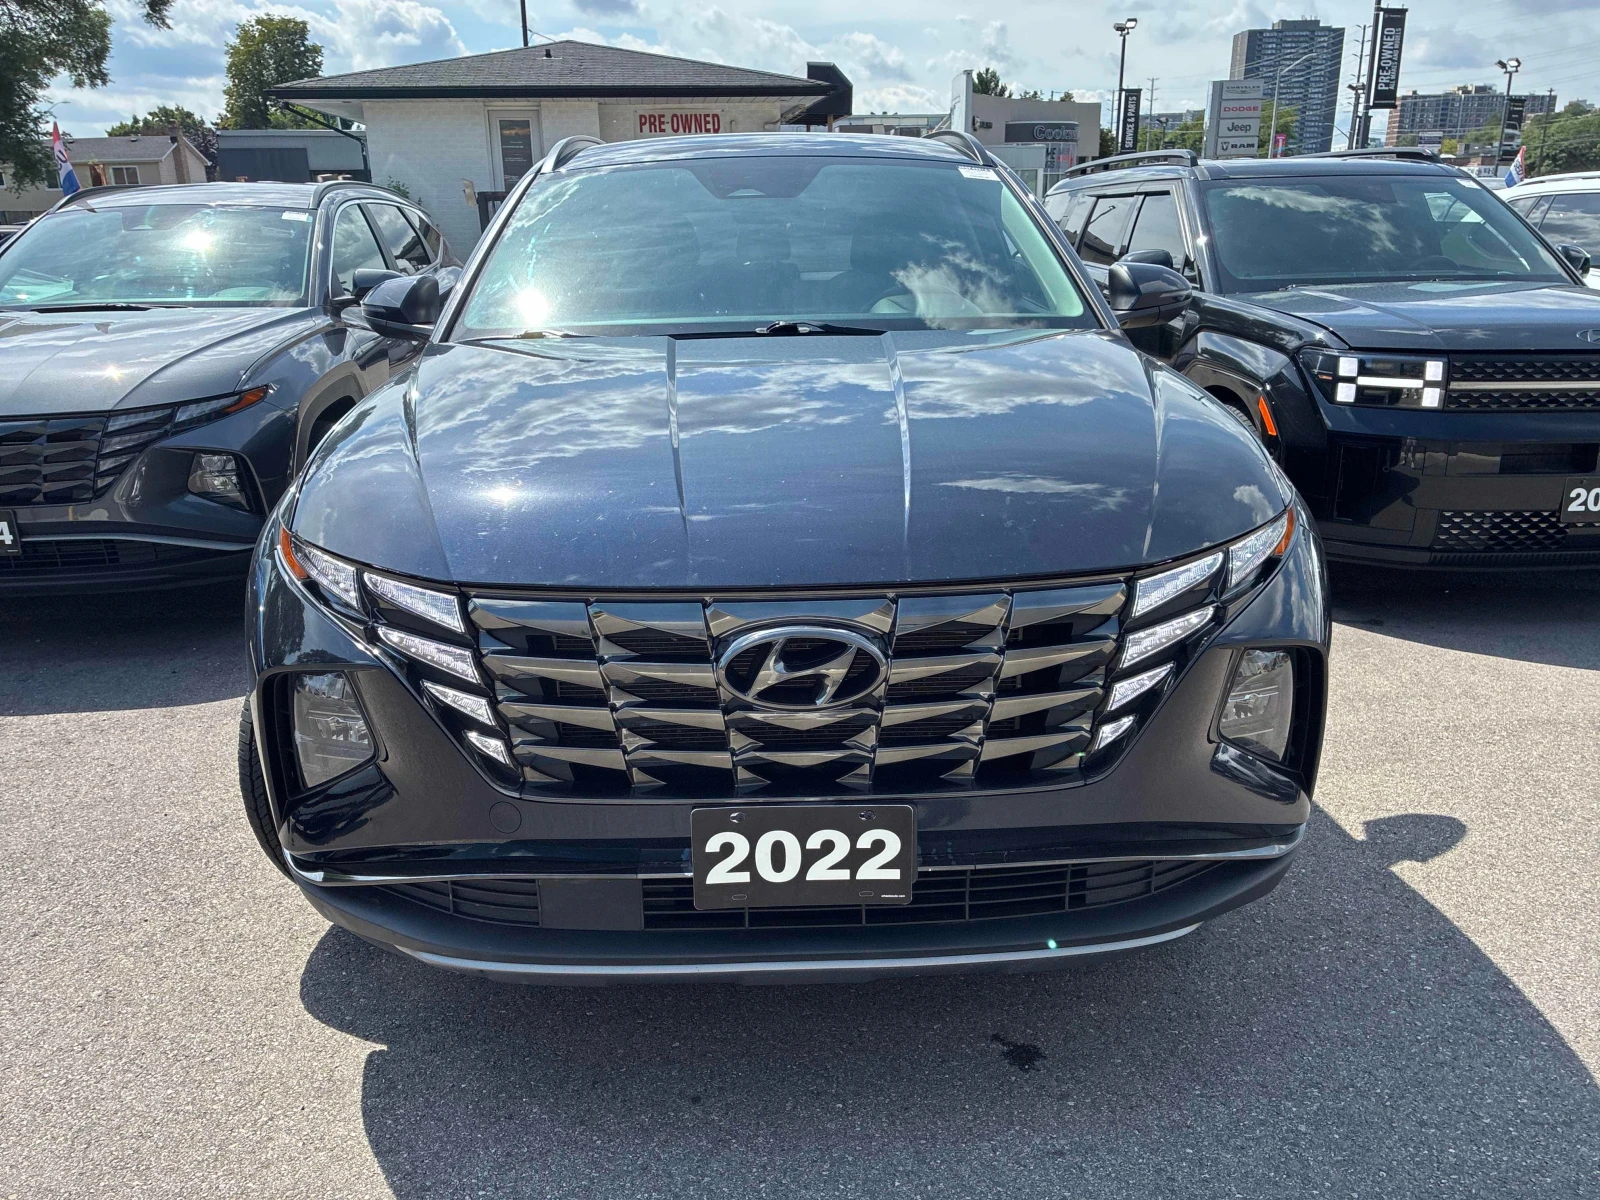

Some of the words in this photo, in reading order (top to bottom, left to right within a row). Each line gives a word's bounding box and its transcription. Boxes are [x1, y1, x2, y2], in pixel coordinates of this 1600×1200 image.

[1378, 27, 1396, 90] PRE-OWNED
[1390, 61, 1398, 79] MAKES
[1127, 96, 1137, 116] PARTS
[639, 113, 721, 133] PRE-OWNED
[1227, 122, 1251, 133] Jeep
[1125, 123, 1135, 149] SERVICE
[1567, 487, 1600, 512] 20
[705, 828, 902, 885] 2022
